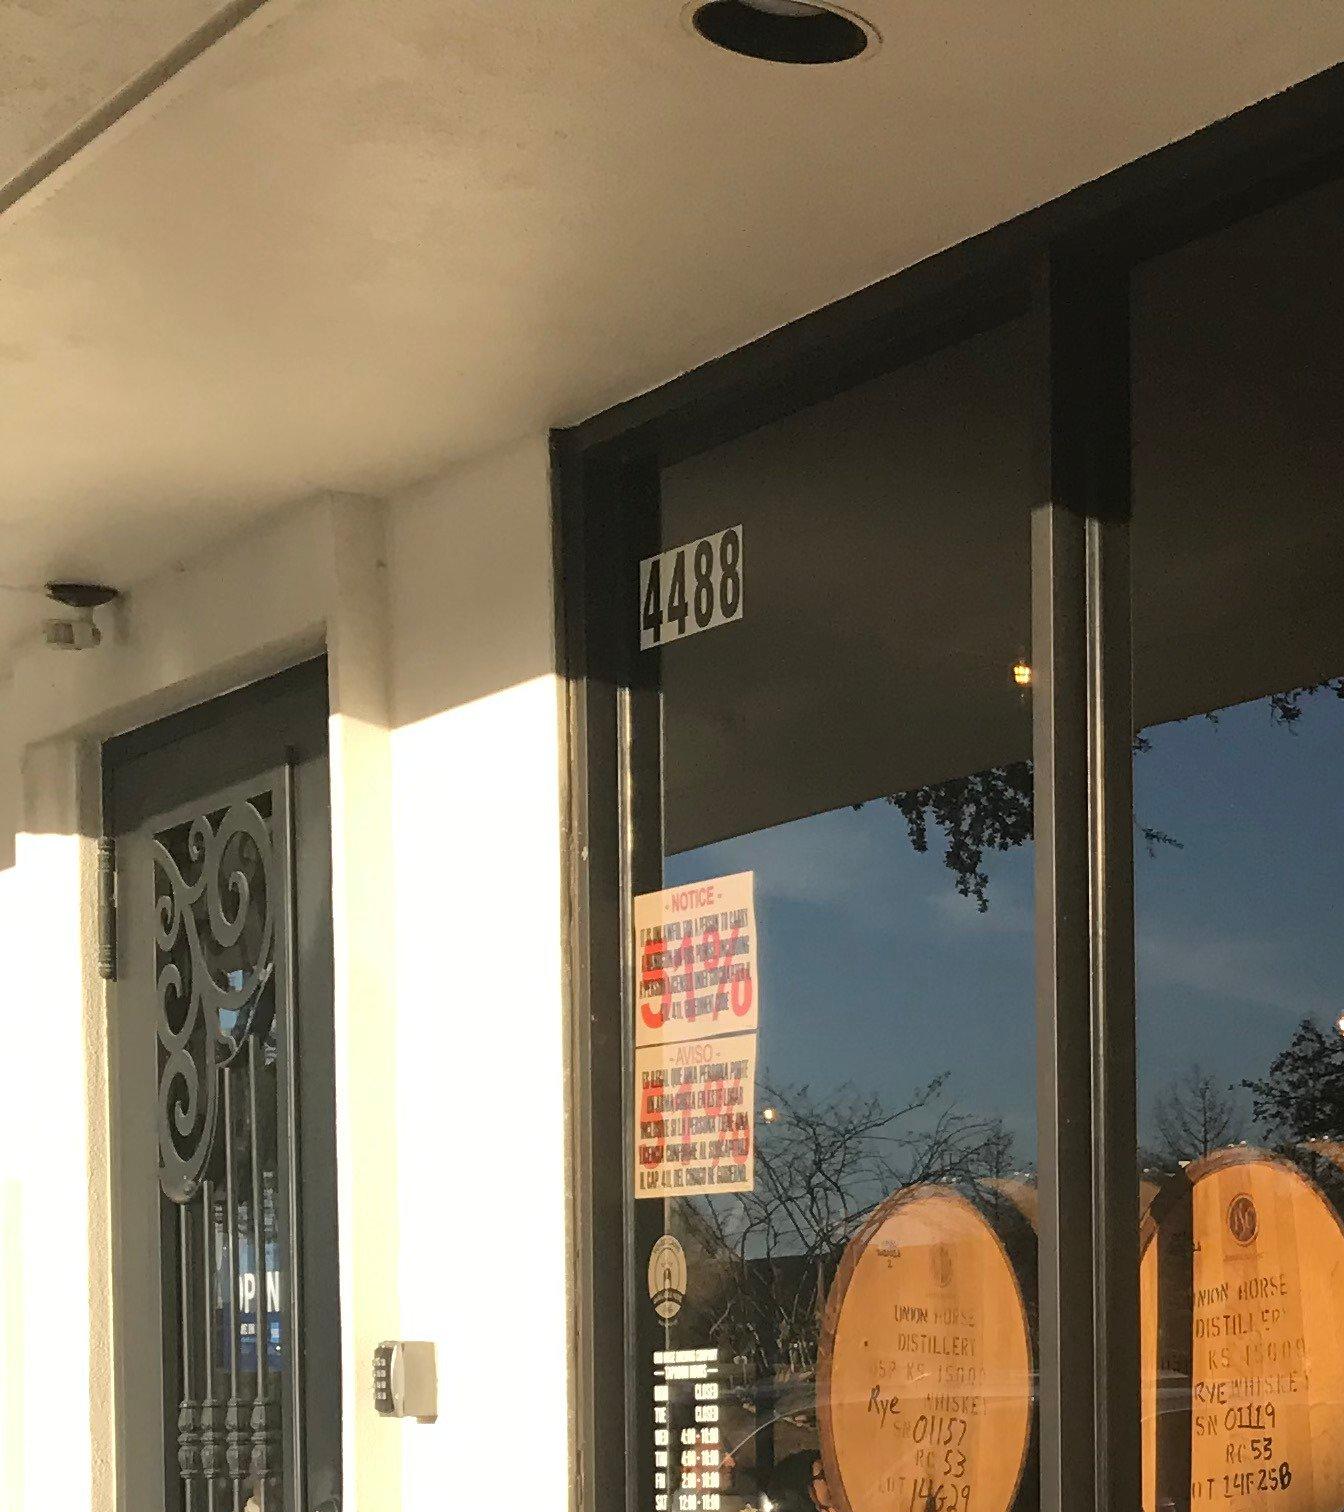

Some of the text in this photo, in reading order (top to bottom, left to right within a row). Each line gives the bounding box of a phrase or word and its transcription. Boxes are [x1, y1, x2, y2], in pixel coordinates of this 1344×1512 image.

[643, 529, 740, 643] 4488
[671, 886, 714, 912] NOTICE
[676, 1044, 713, 1065] AVISO
[1195, 1273, 1287, 1308] NION HORSE
[894, 1304, 928, 1324] UNION
[898, 1333, 976, 1357] DISTILLERY
[1208, 1348, 1230, 1370] KS
[1194, 1381, 1227, 1404] RYE
[868, 1384, 900, 1429] Rye
[1195, 1402, 1276, 1436] SN 01119
[912, 1415, 967, 1446] 01157
[943, 1449, 966, 1478] 53
[1226, 1437, 1273, 1464] RC 53
